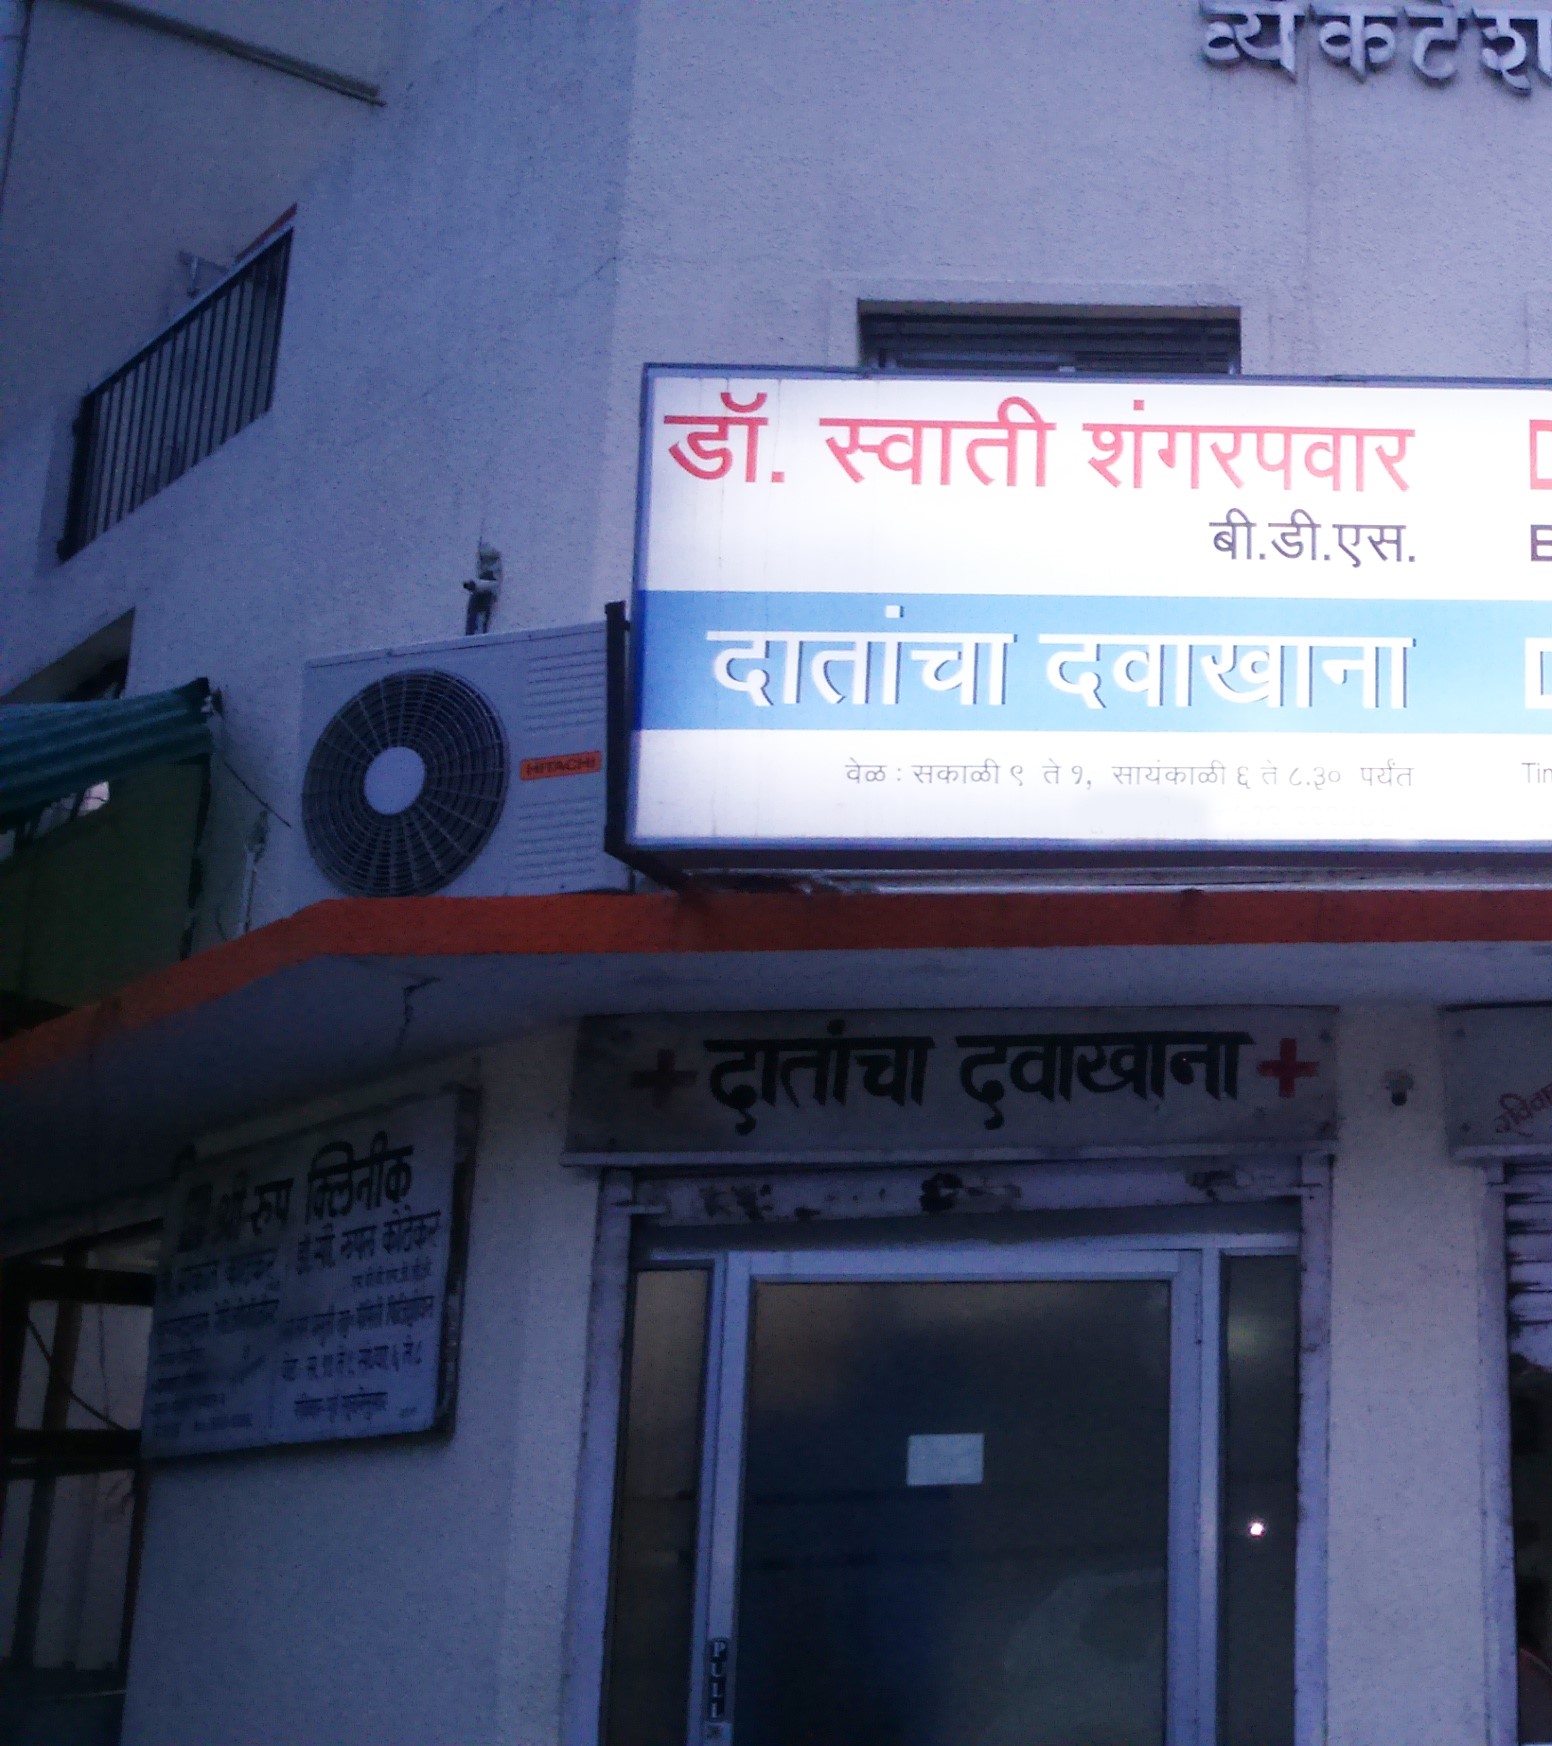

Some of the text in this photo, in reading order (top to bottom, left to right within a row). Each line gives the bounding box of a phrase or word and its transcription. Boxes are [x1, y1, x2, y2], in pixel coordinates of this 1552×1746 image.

[664, 391, 1416, 493] डॉ. स्वाती शंगरपवार
[1209, 508, 1417, 567] बी.डी.एस.
[705, 604, 1417, 710] दातांचा दवाखाना
[526, 758, 596, 777] HITACHI
[912, 758, 1001, 788] सकाळी
[1042, 758, 1061, 787] ते
[1112, 758, 1226, 787] सायंकाळी
[1236, 764, 1251, 790] ६
[1260, 758, 1278, 786] ते
[704, 1019, 1254, 1135] दातांचा दवाखाना
